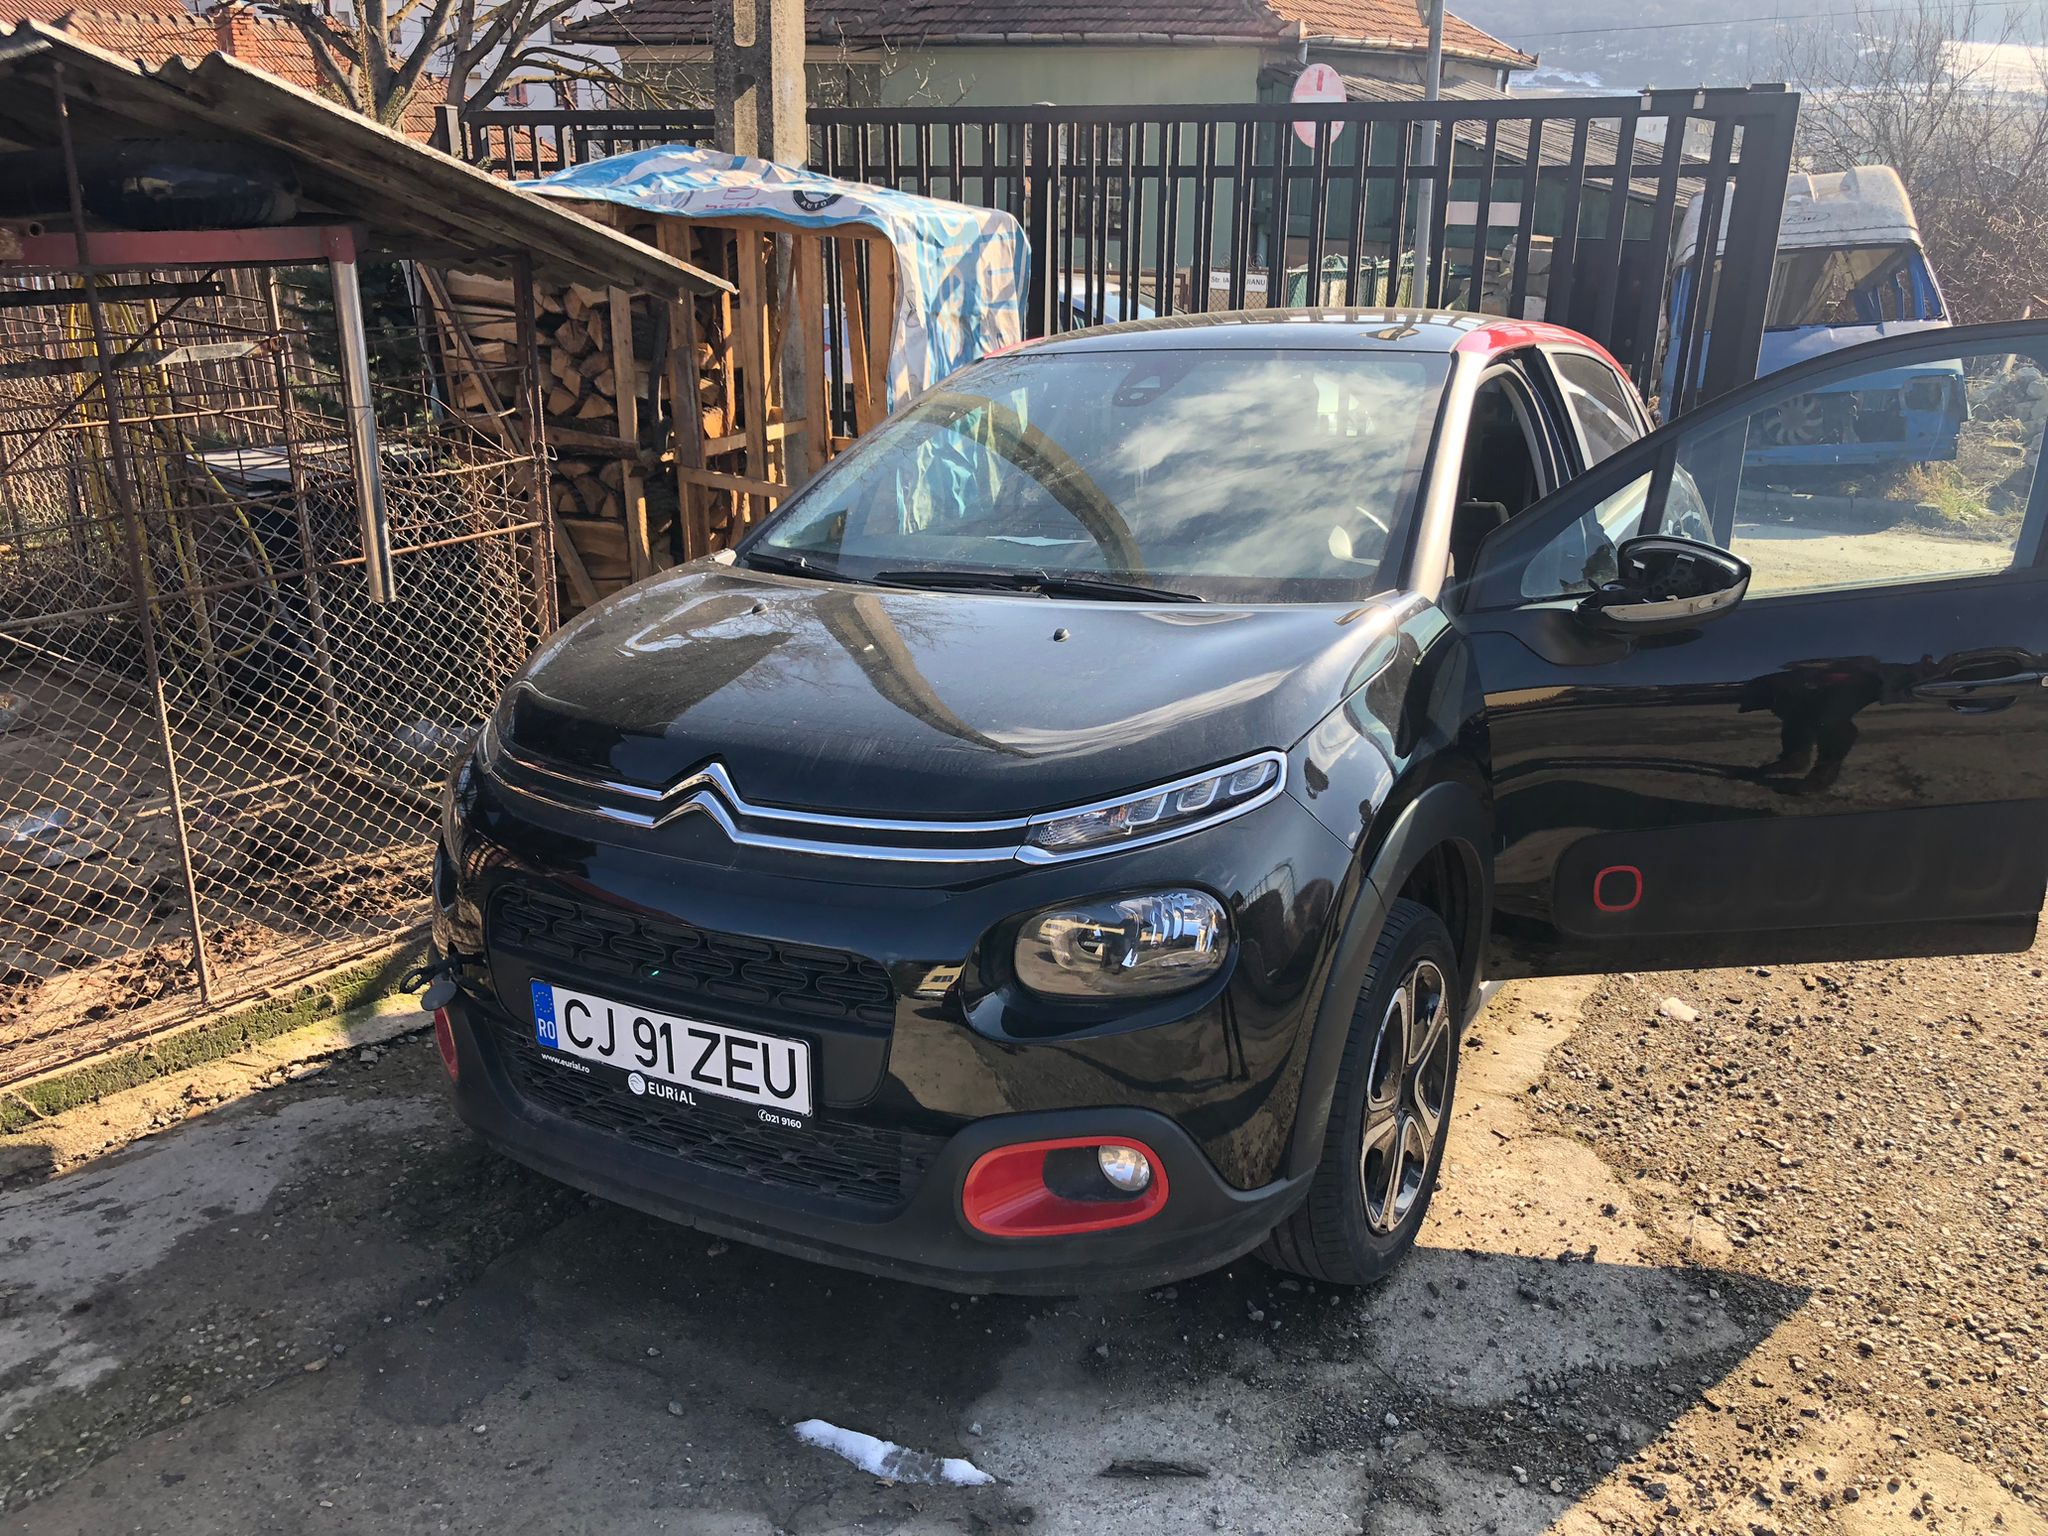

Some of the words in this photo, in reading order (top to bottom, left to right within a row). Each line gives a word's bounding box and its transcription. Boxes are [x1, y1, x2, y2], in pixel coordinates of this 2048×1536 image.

[801, 201, 827, 211] AUTO
[538, 1018, 556, 1040] RO
[564, 998, 616, 1056] CJ
[632, 1016, 675, 1074] 91
[687, 1027, 796, 1099] ZEU
[541, 1053, 590, 1074] www.eurial.ro
[765, 1113, 780, 1124] 021
[781, 1116, 802, 1129] 9160
